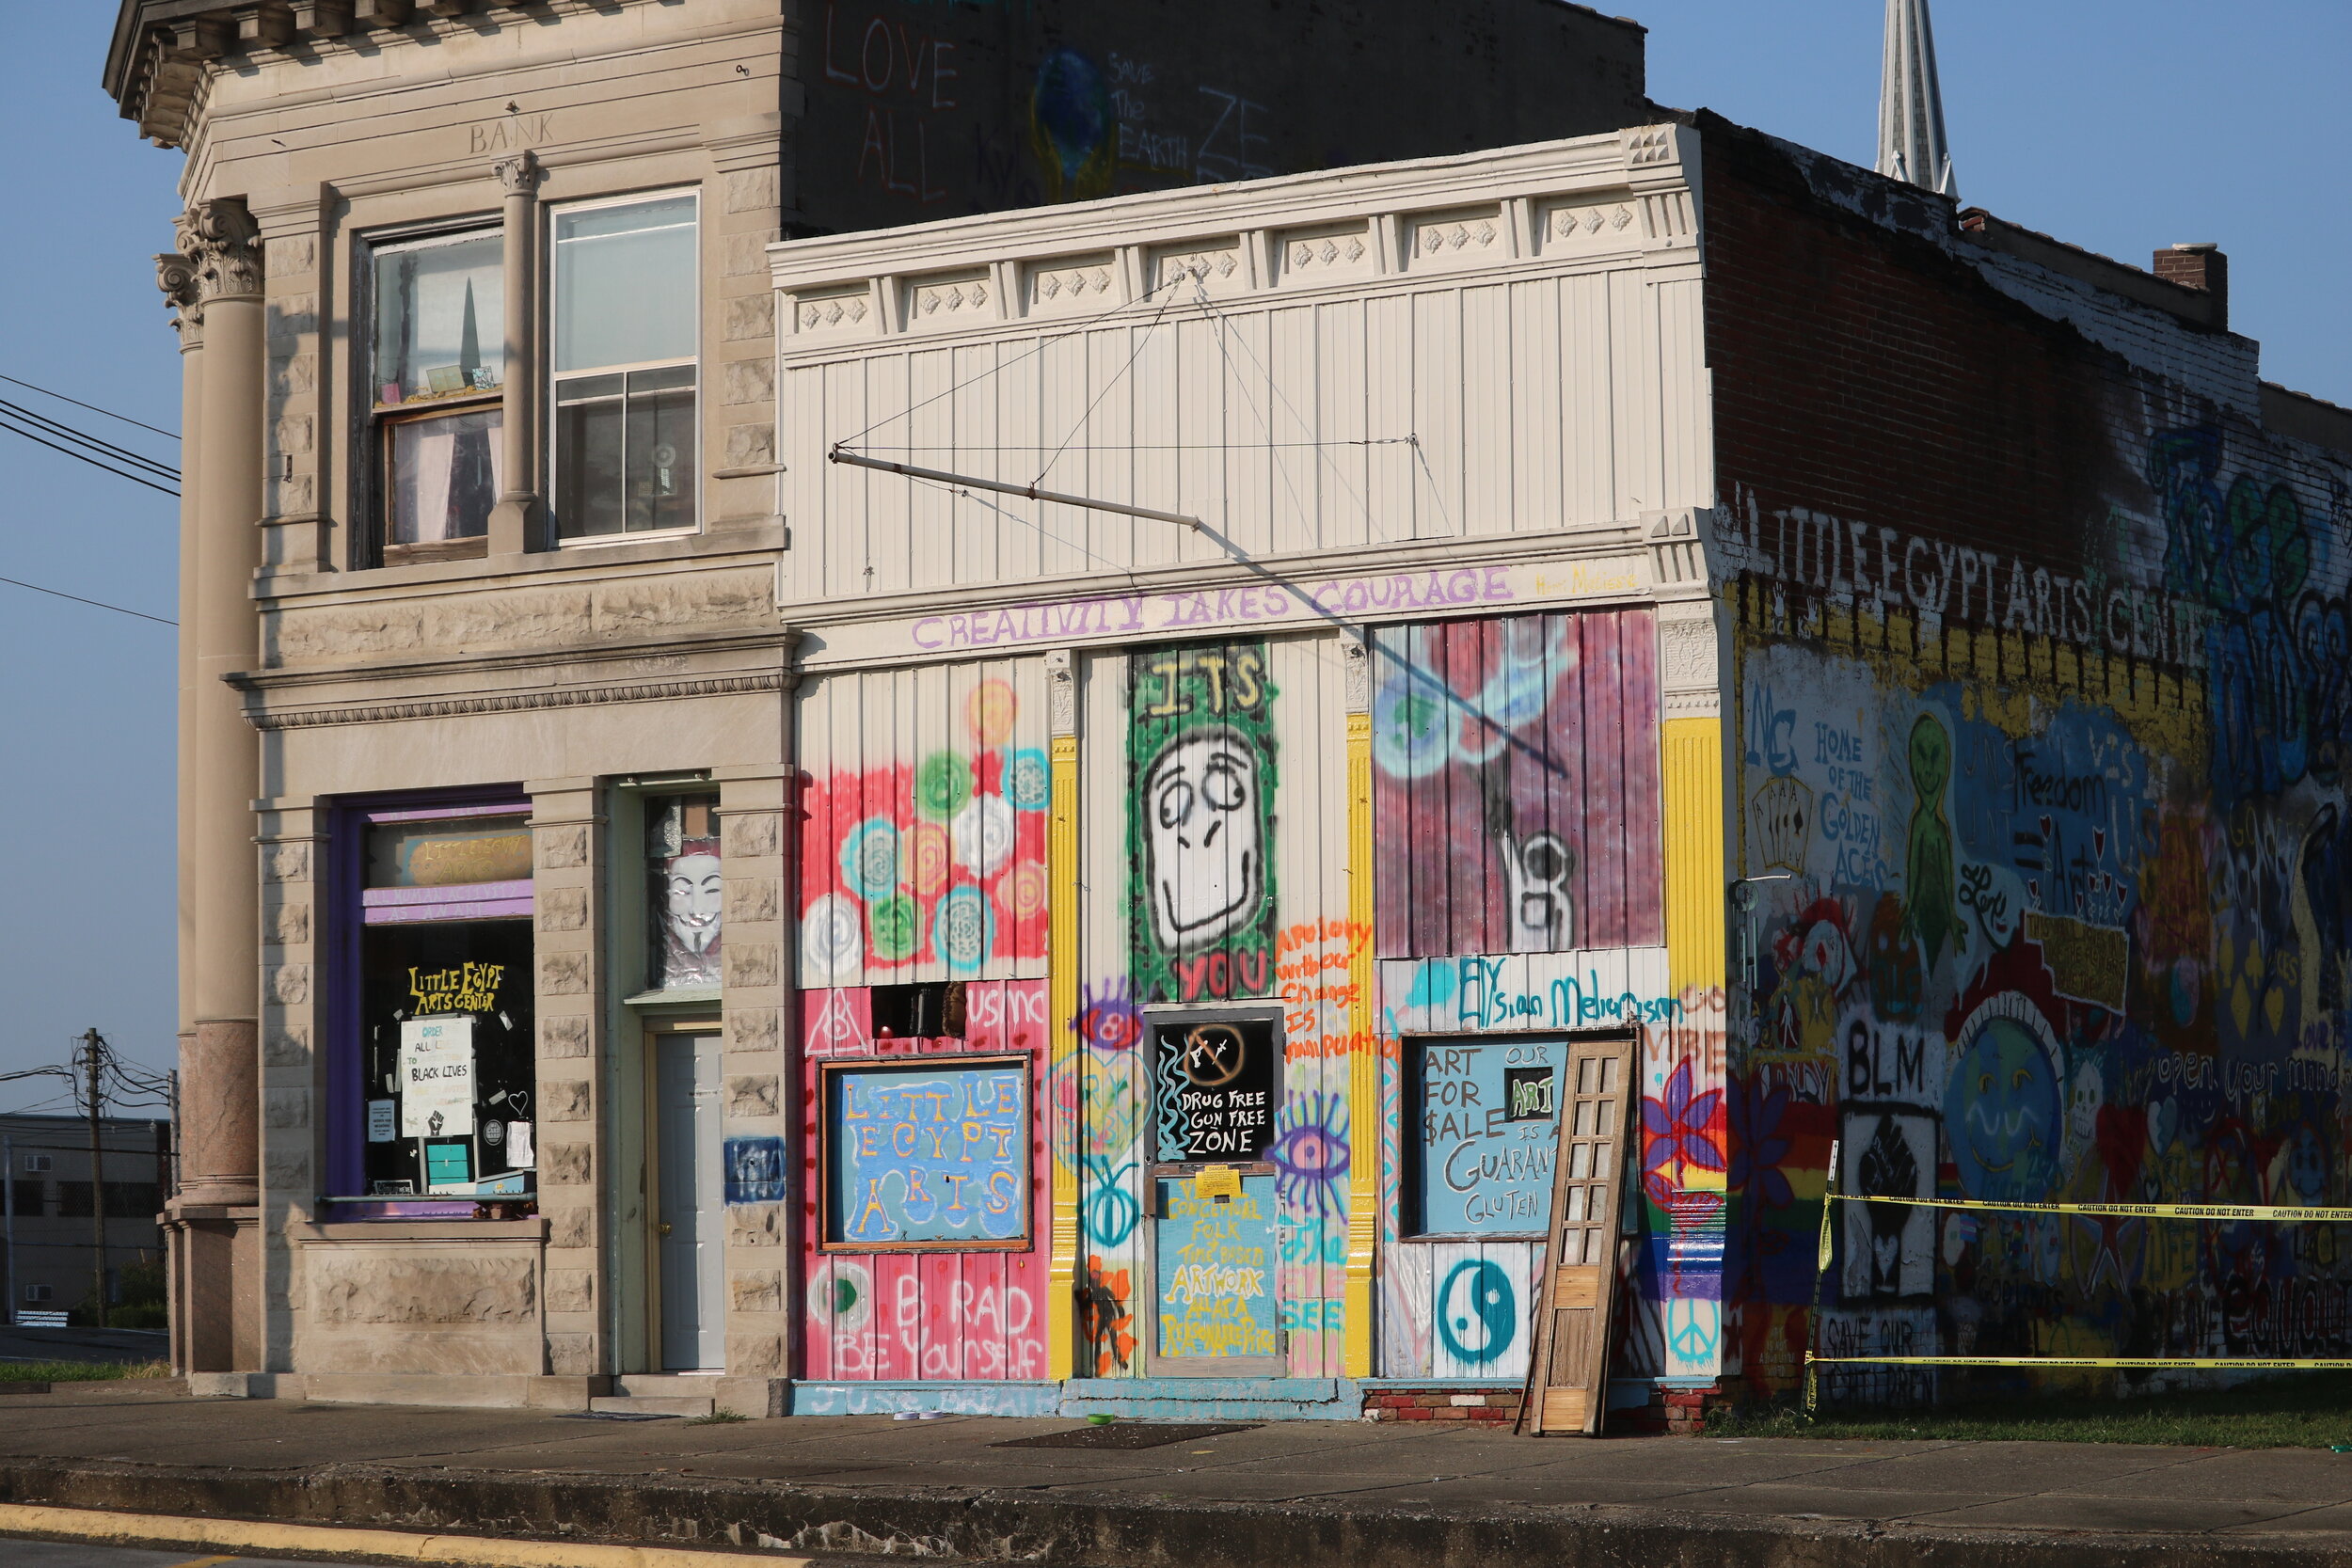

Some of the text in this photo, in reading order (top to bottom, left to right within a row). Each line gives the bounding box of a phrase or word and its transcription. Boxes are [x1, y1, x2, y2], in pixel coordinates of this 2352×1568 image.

[824, 2, 958, 110] LOVE
[1107, 52, 1156, 85] SAVE
[469, 112, 555, 154] BANK
[1117, 121, 1189, 172] EARTH
[857, 104, 947, 204] ALL
[1745, 487, 2211, 670] LITTLE EGYPT ARTS CENTE
[911, 593, 1144, 650] CREATIVITY
[1310, 566, 1515, 612] COURAGE
[1146, 650, 1264, 716] ITS
[1814, 721, 1863, 765] HOME
[1828, 765, 1874, 801] OF THE
[1820, 792, 1881, 860] GOLDEN
[407, 961, 505, 998] LITTLE EGYPT
[1169, 947, 1270, 1001] YOU
[414, 990, 496, 1015] ARTS CENTER
[414, 1041, 431, 1053] ALL
[421, 1025, 443, 1038] ORDER
[406, 1057, 418, 1066] TO
[411, 1064, 468, 1082] BLACK LIVES
[1422, 1048, 1484, 1077] ART
[1505, 1045, 1549, 1065] OUR
[1849, 1019, 1925, 1097] BLM
[846, 1083, 1017, 1122] LITTLE
[1053, 1071, 1129, 1114] CRY
[1182, 1090, 1265, 1112] DRUG FREE
[1423, 1081, 1484, 1108] FOR
[1511, 1076, 1553, 1117] ART
[1191, 1109, 1265, 1130] GUN FREE
[1518, 1125, 1540, 1141] IS
[1187, 1128, 1254, 1154] ZONE
[857, 1169, 1016, 1233] ARTS
[1464, 1190, 1539, 1225] GLUTEN
[2077, 1204, 2157, 1214] CAUTION DO NOT ENTER
[2175, 1207, 2254, 1216] CAUTION DO NOT ENTER
[2272, 1209, 2352, 1219] CAUTION DO NOT ENTER
[1191, 1220, 1242, 1241] FOLK
[1177, 1241, 1264, 1267] TIME BASED
[897, 1275, 1033, 1336] B RAD
[834, 1332, 891, 1372] BE
[1827, 1316, 1874, 1358] SAVE
